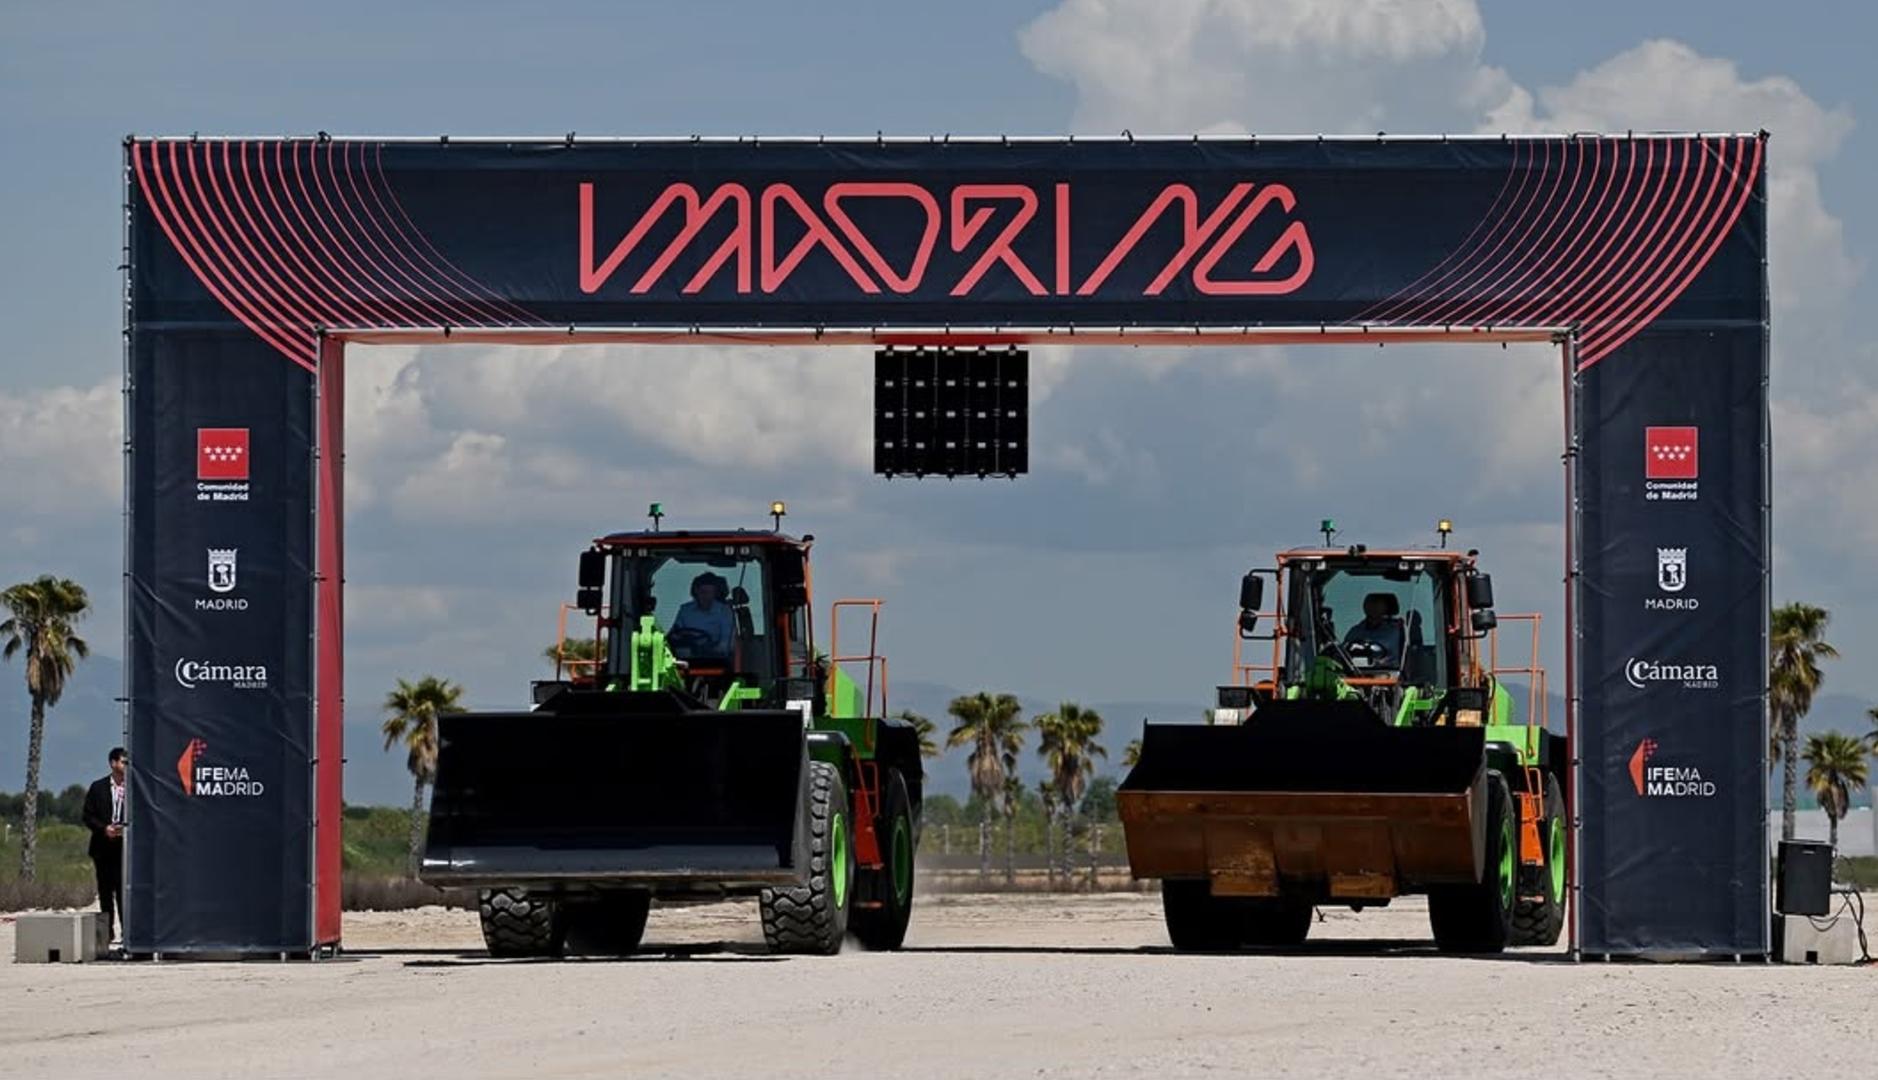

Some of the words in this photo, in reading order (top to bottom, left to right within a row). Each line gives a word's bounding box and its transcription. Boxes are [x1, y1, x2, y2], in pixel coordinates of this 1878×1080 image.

[579, 182, 1315, 296] MADRING
[197, 482, 249, 492] Comunidad
[1645, 481, 1698, 490] Comunidad
[197, 492, 211, 501] de
[213, 492, 249, 501] Madrid
[1645, 491, 1660, 500] de
[1661, 491, 1698, 500] Madrid
[195, 599, 249, 611] MADRID
[1645, 598, 1699, 610] MADRID
[176, 659, 267, 682] Cámara
[1626, 659, 1719, 682] Cámara
[233, 681, 268, 689] MADRID
[1683, 680, 1719, 689] MADRID
[195, 767, 250, 781] IFEMA
[1647, 767, 1701, 781] IFEMA
[195, 781, 264, 796] MADRID
[1647, 781, 1716, 796] MADRID
